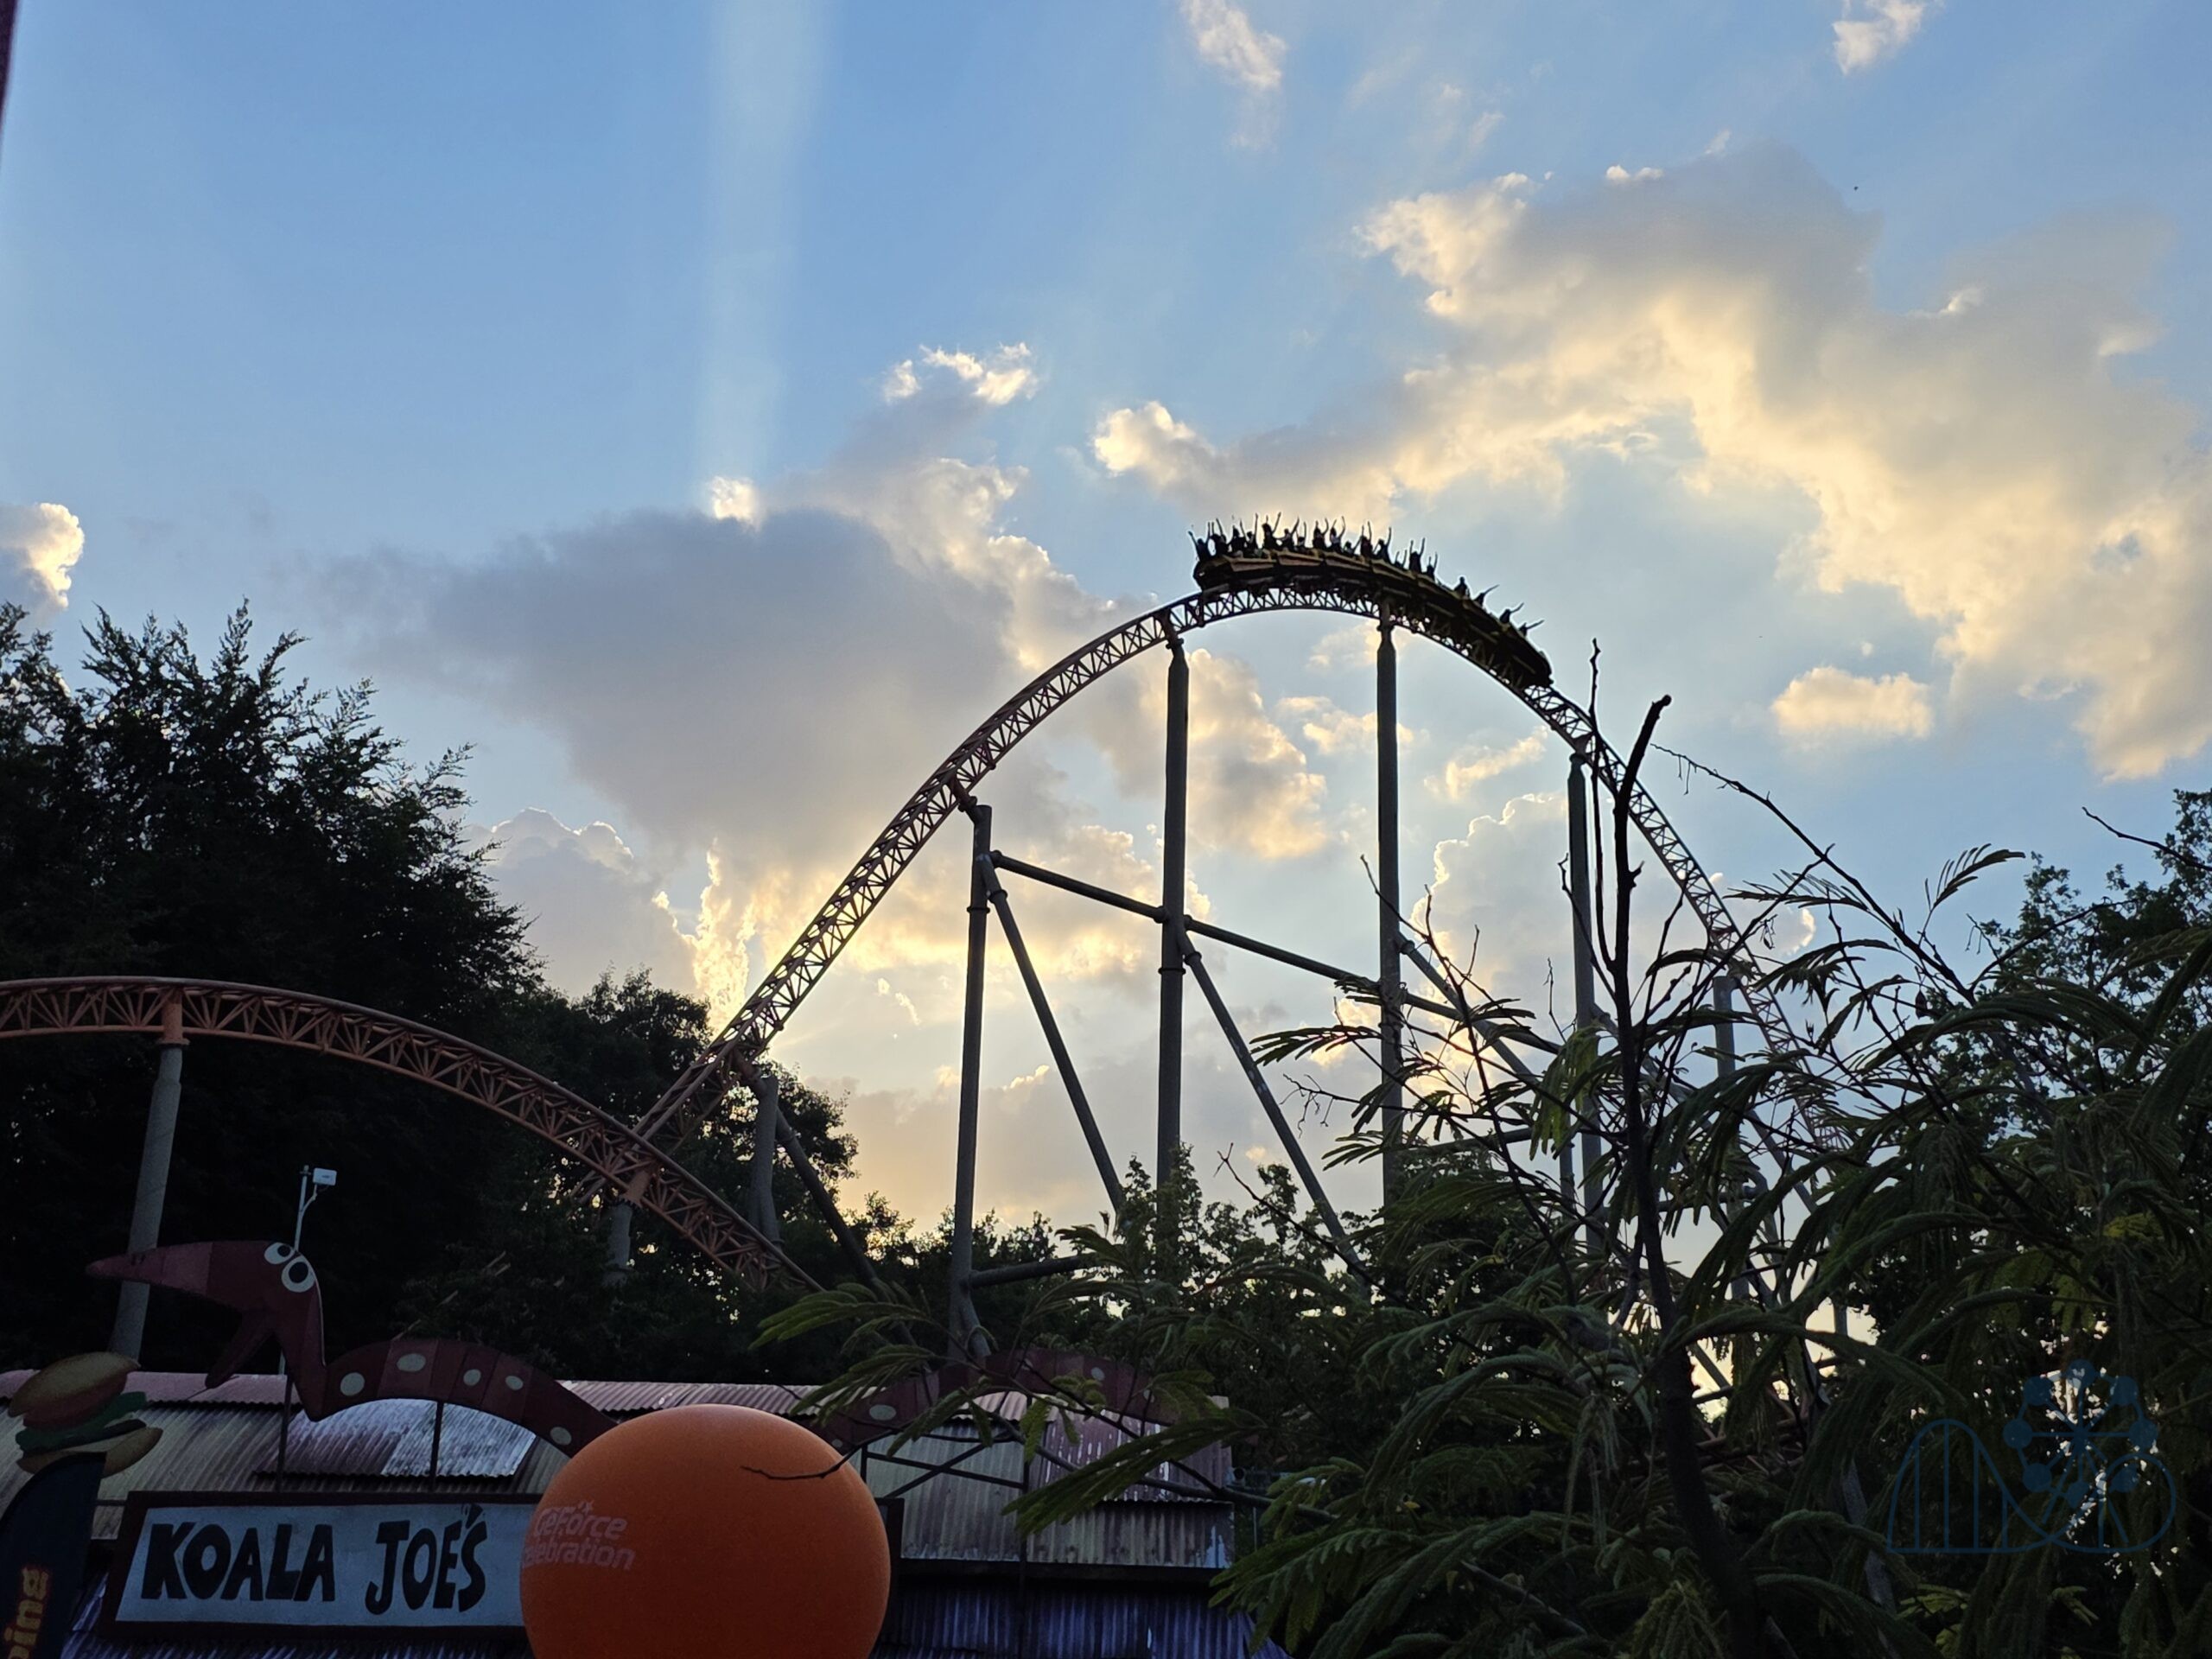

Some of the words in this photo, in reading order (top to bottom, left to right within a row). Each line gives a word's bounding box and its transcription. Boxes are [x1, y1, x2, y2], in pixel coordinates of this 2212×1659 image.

[140, 1521, 336, 1602] KOALA
[364, 1503, 488, 1615] JOE'S
[522, 1536, 637, 1571] elebration
